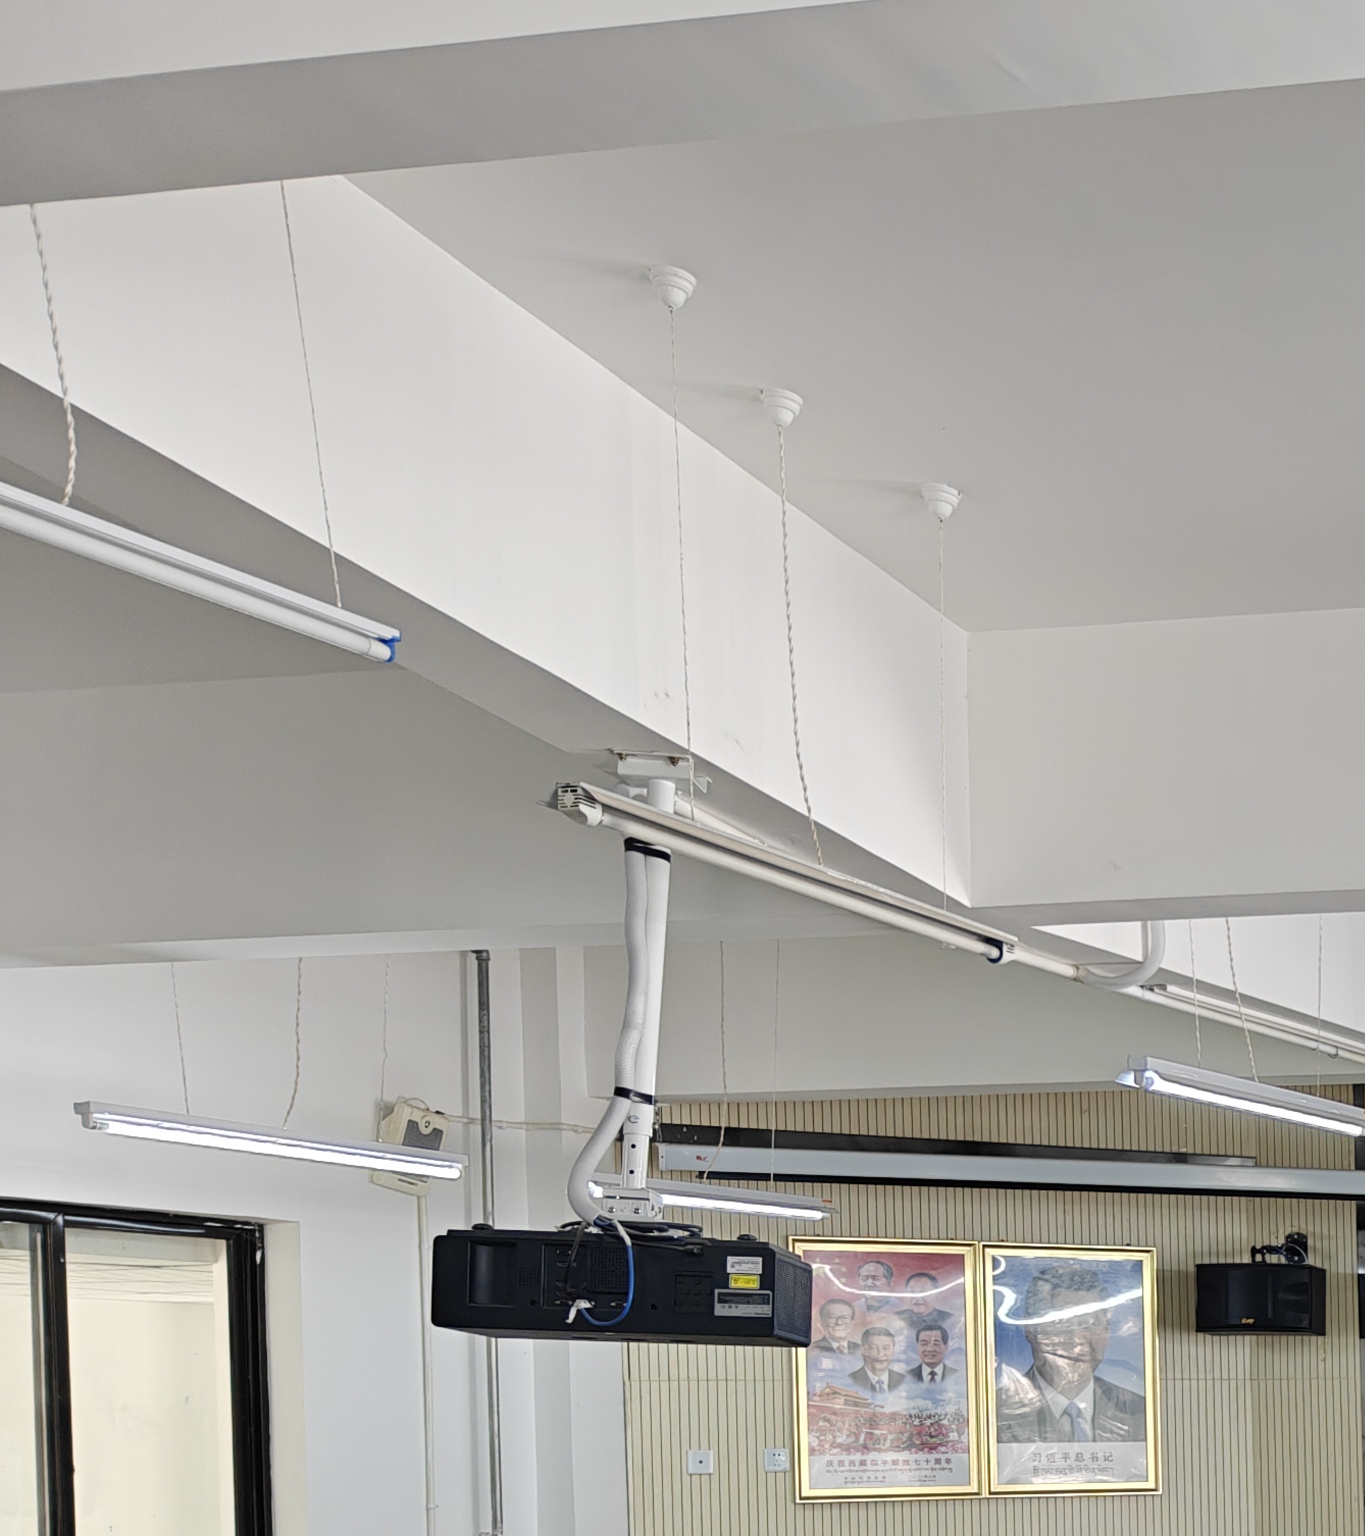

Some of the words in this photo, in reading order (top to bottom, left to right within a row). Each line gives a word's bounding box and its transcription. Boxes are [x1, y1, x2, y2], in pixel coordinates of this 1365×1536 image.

[1032, 1451, 1114, 1463] 习近平总书记
[826, 1458, 953, 1468] 庆祝西藏和平解放七十周年
